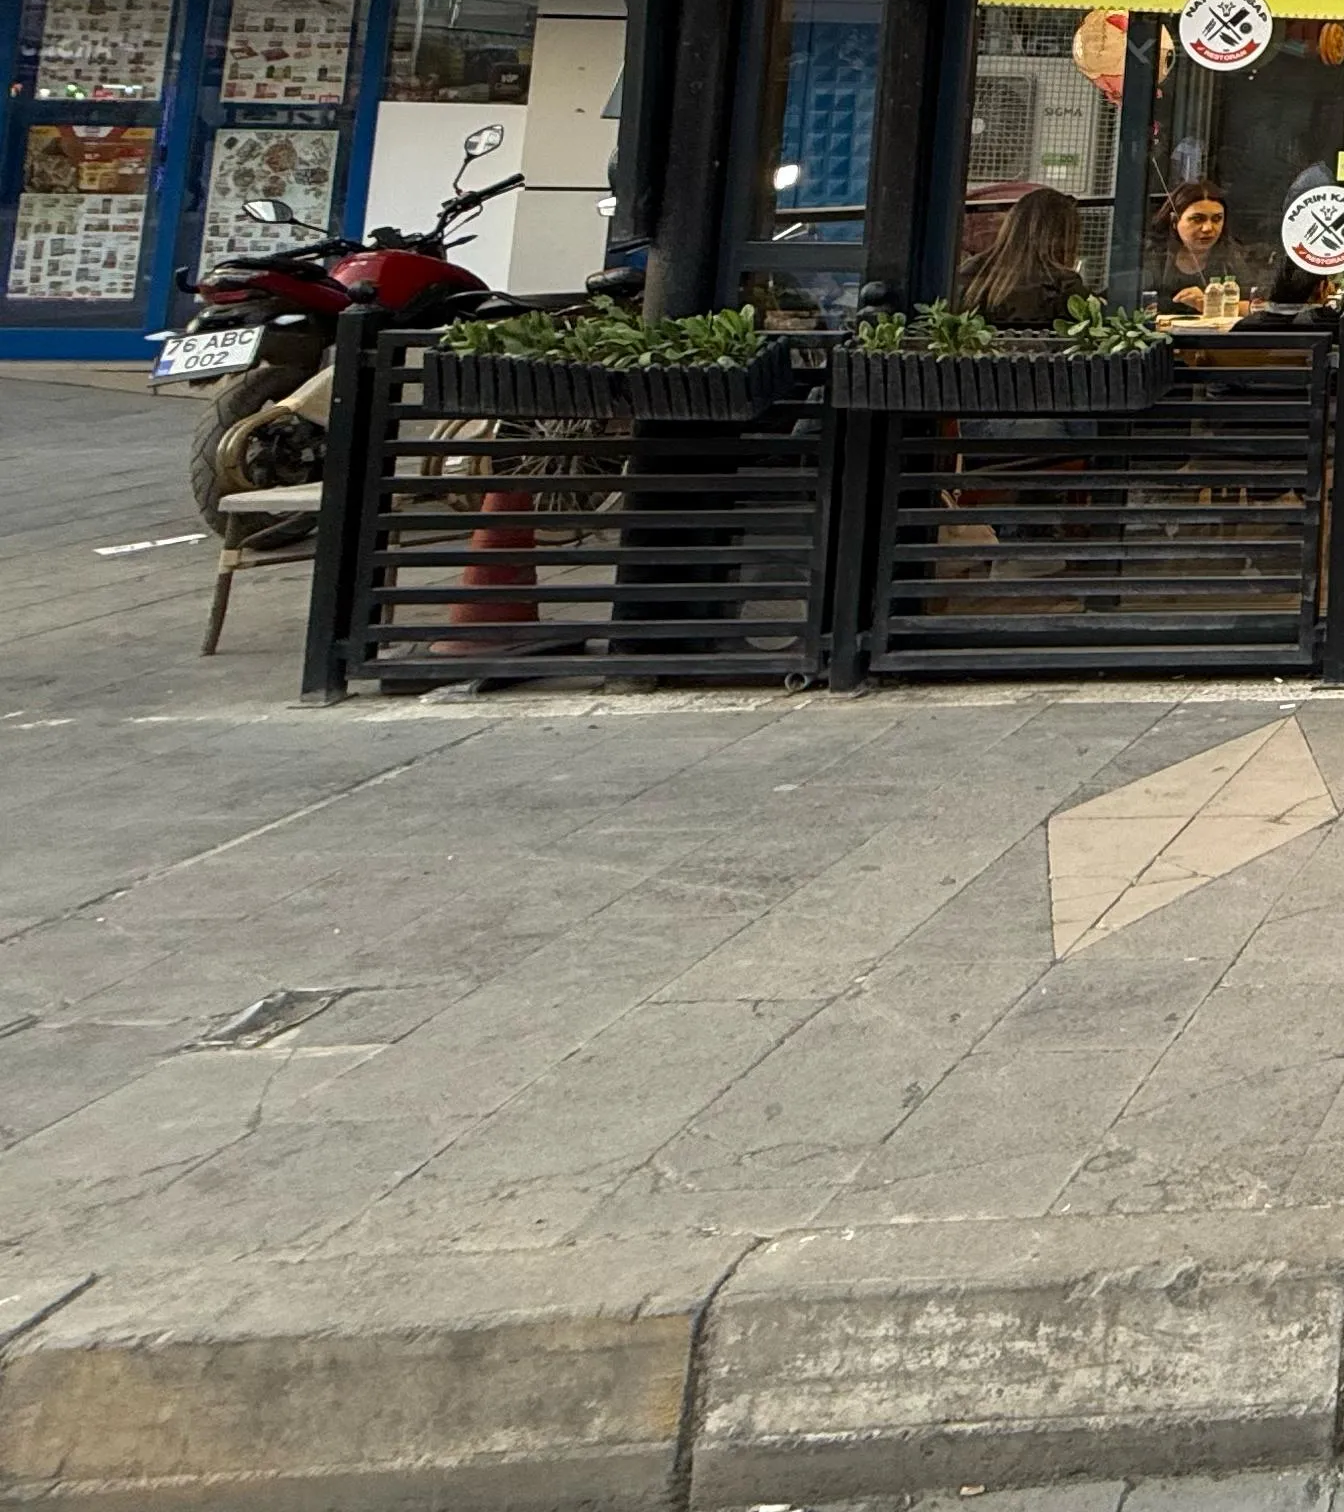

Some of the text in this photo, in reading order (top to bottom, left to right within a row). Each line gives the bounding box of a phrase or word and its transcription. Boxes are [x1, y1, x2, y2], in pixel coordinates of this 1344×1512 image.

[1044, 106, 1083, 117] SIGMA
[167, 329, 255, 356] 76 ABC
[185, 351, 229, 369] 002
